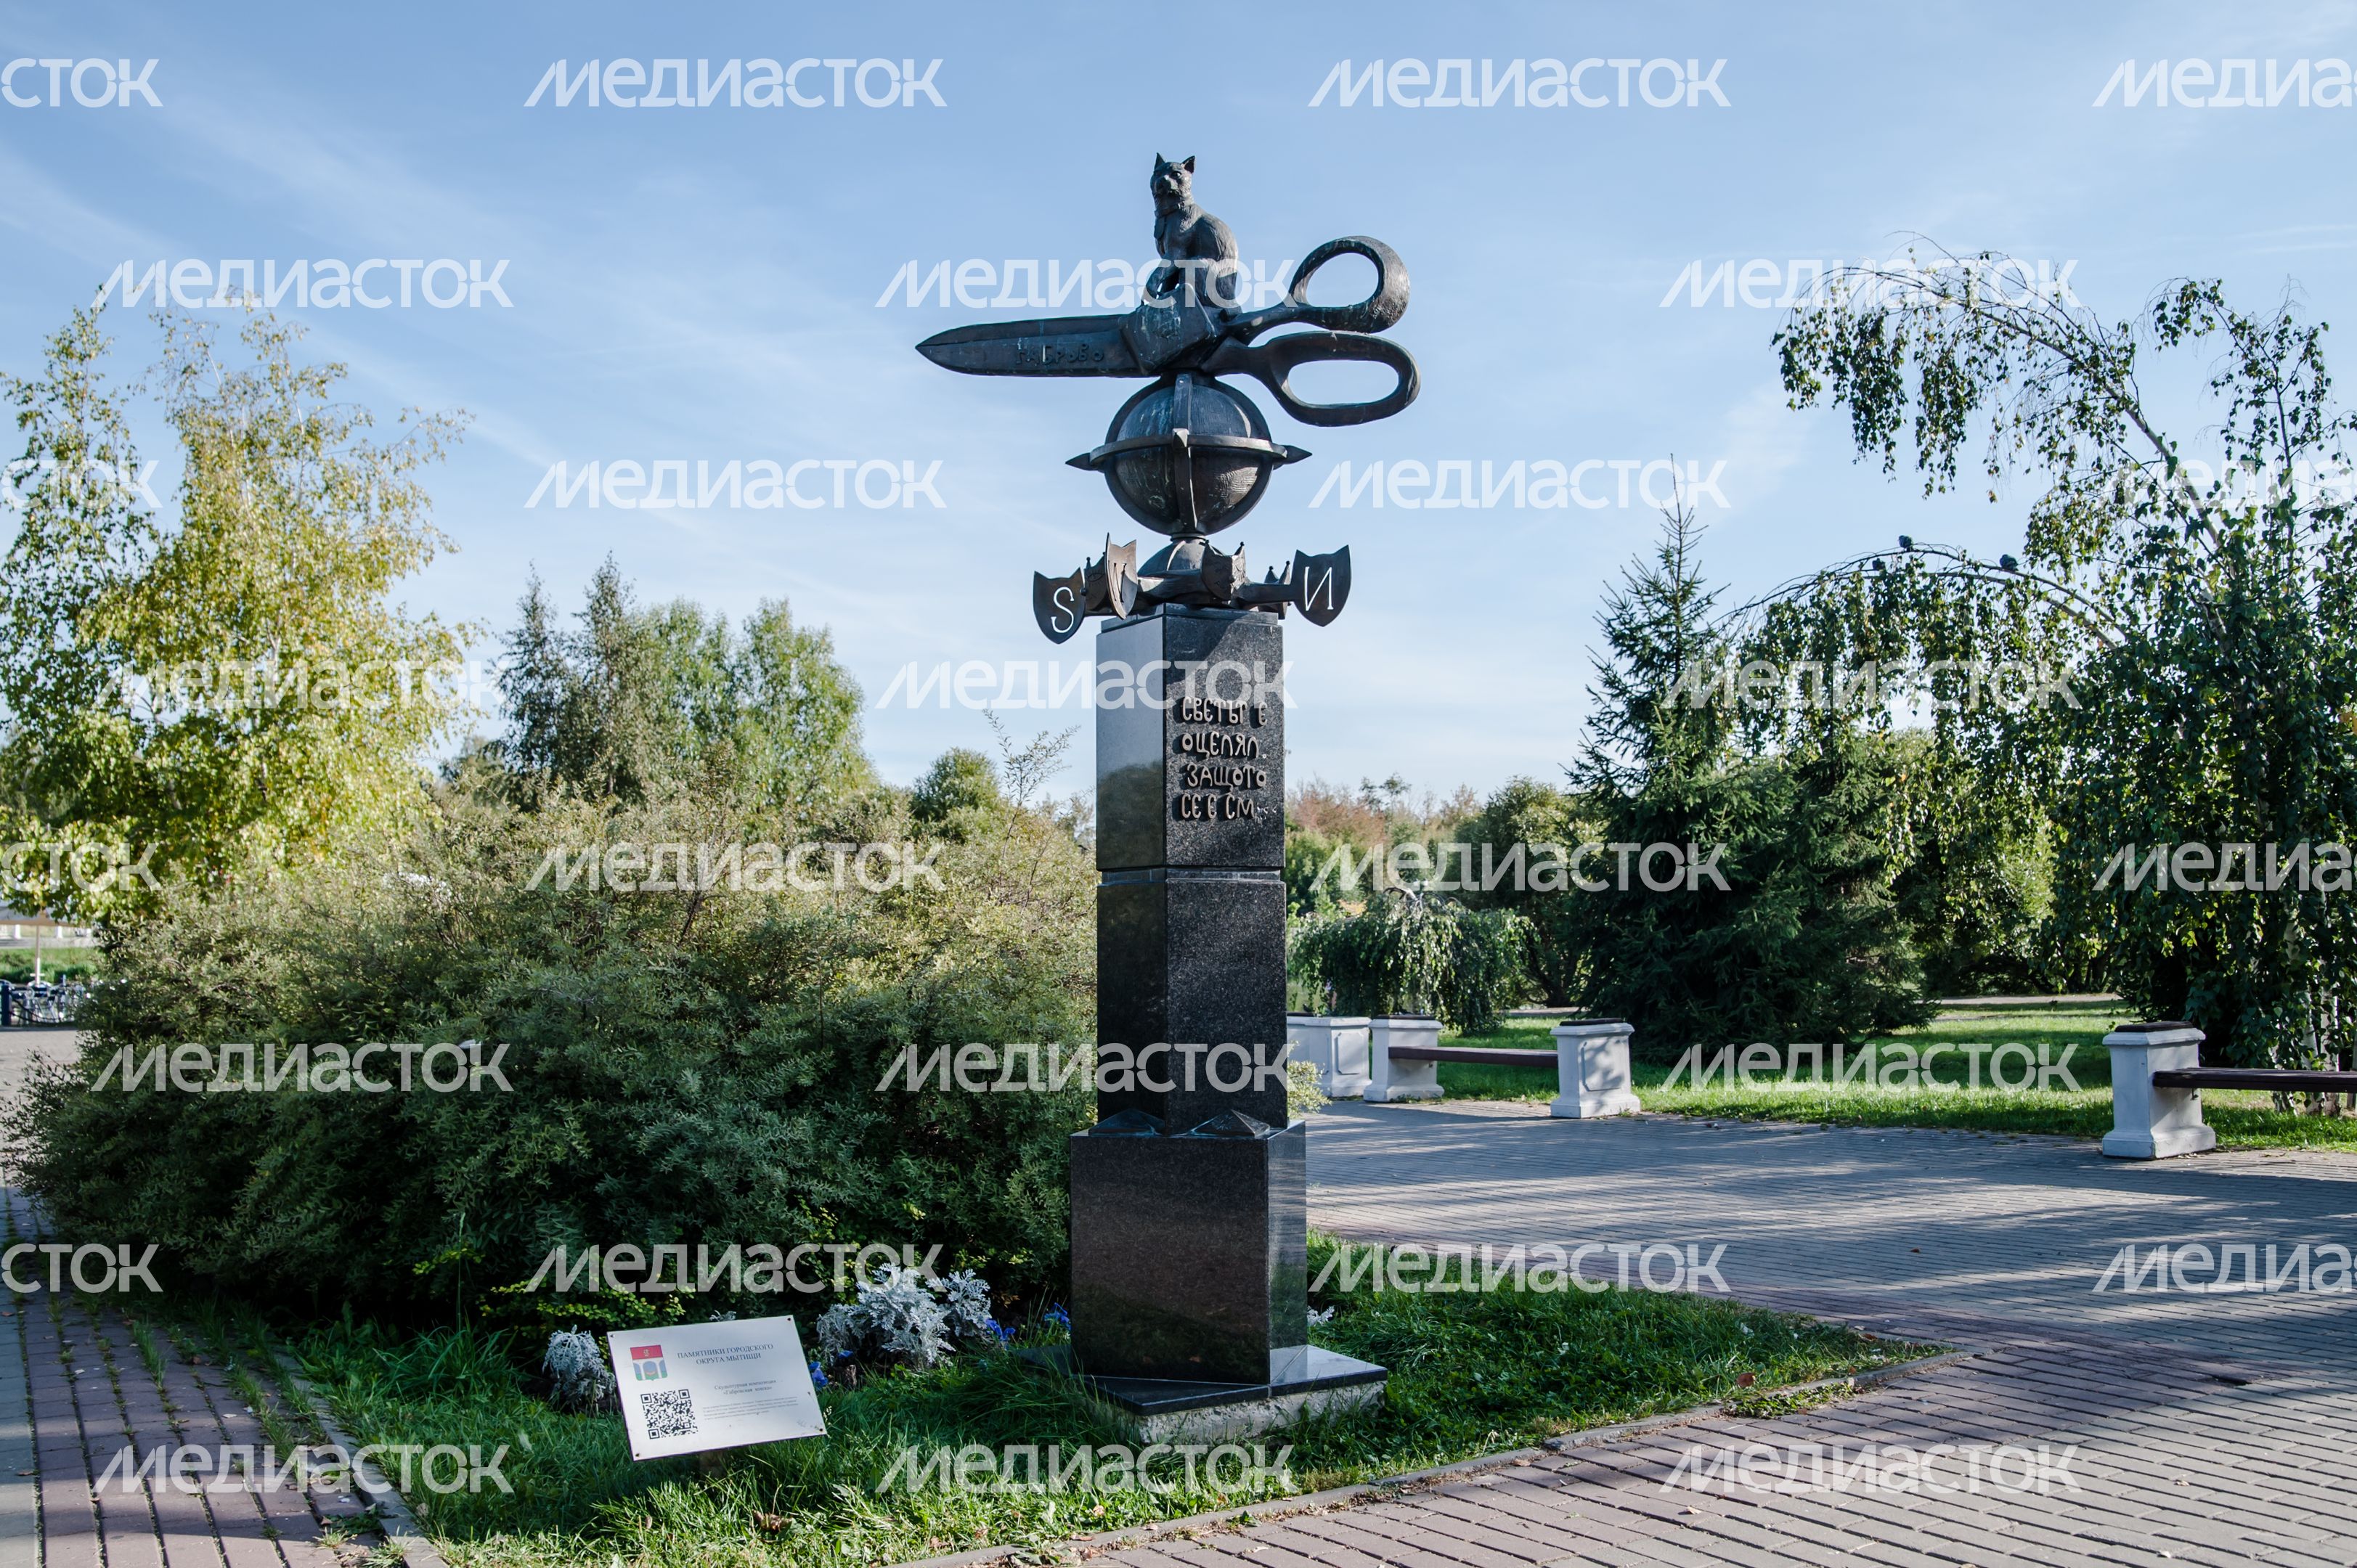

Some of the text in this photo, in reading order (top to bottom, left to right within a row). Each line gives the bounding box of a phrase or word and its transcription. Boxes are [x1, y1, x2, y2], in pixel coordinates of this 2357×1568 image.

[1187, 762, 1266, 793] ЗАЩОТО
[677, 1343, 774, 1359] ПАМЯТНИКИ ГОРОДСКОГО
[696, 1352, 762, 1365] ОКРУГА МЫТИЩИ
